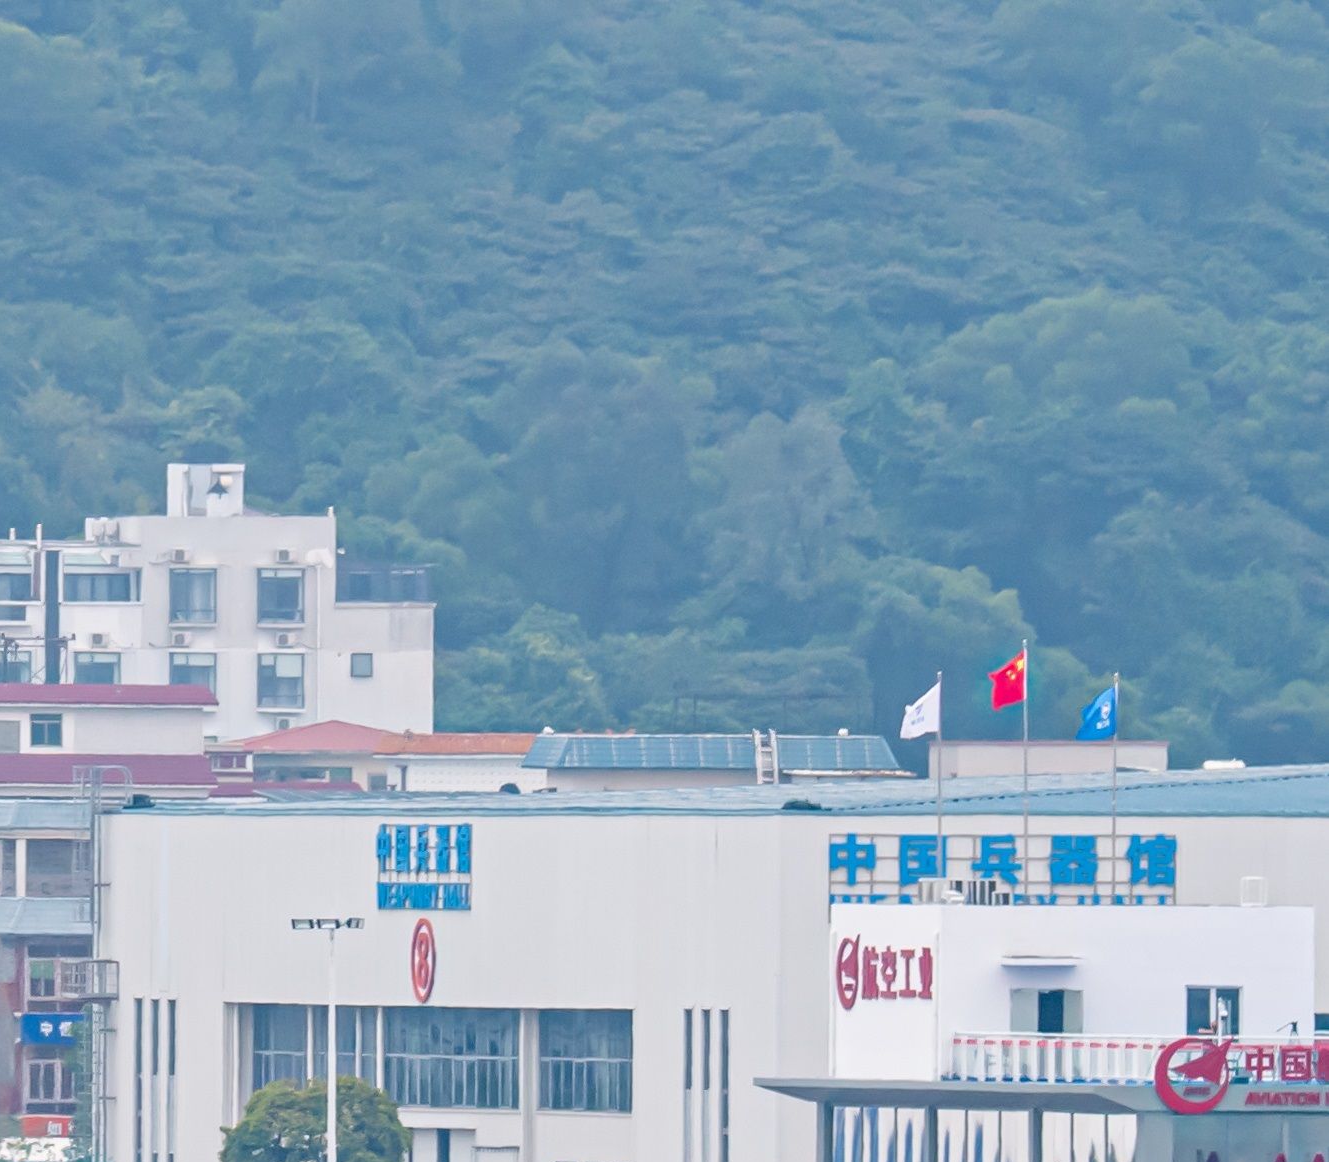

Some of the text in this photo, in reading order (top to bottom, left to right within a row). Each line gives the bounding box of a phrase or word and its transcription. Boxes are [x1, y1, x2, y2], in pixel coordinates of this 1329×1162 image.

[829, 833, 1177, 886] 中国兵器馆
